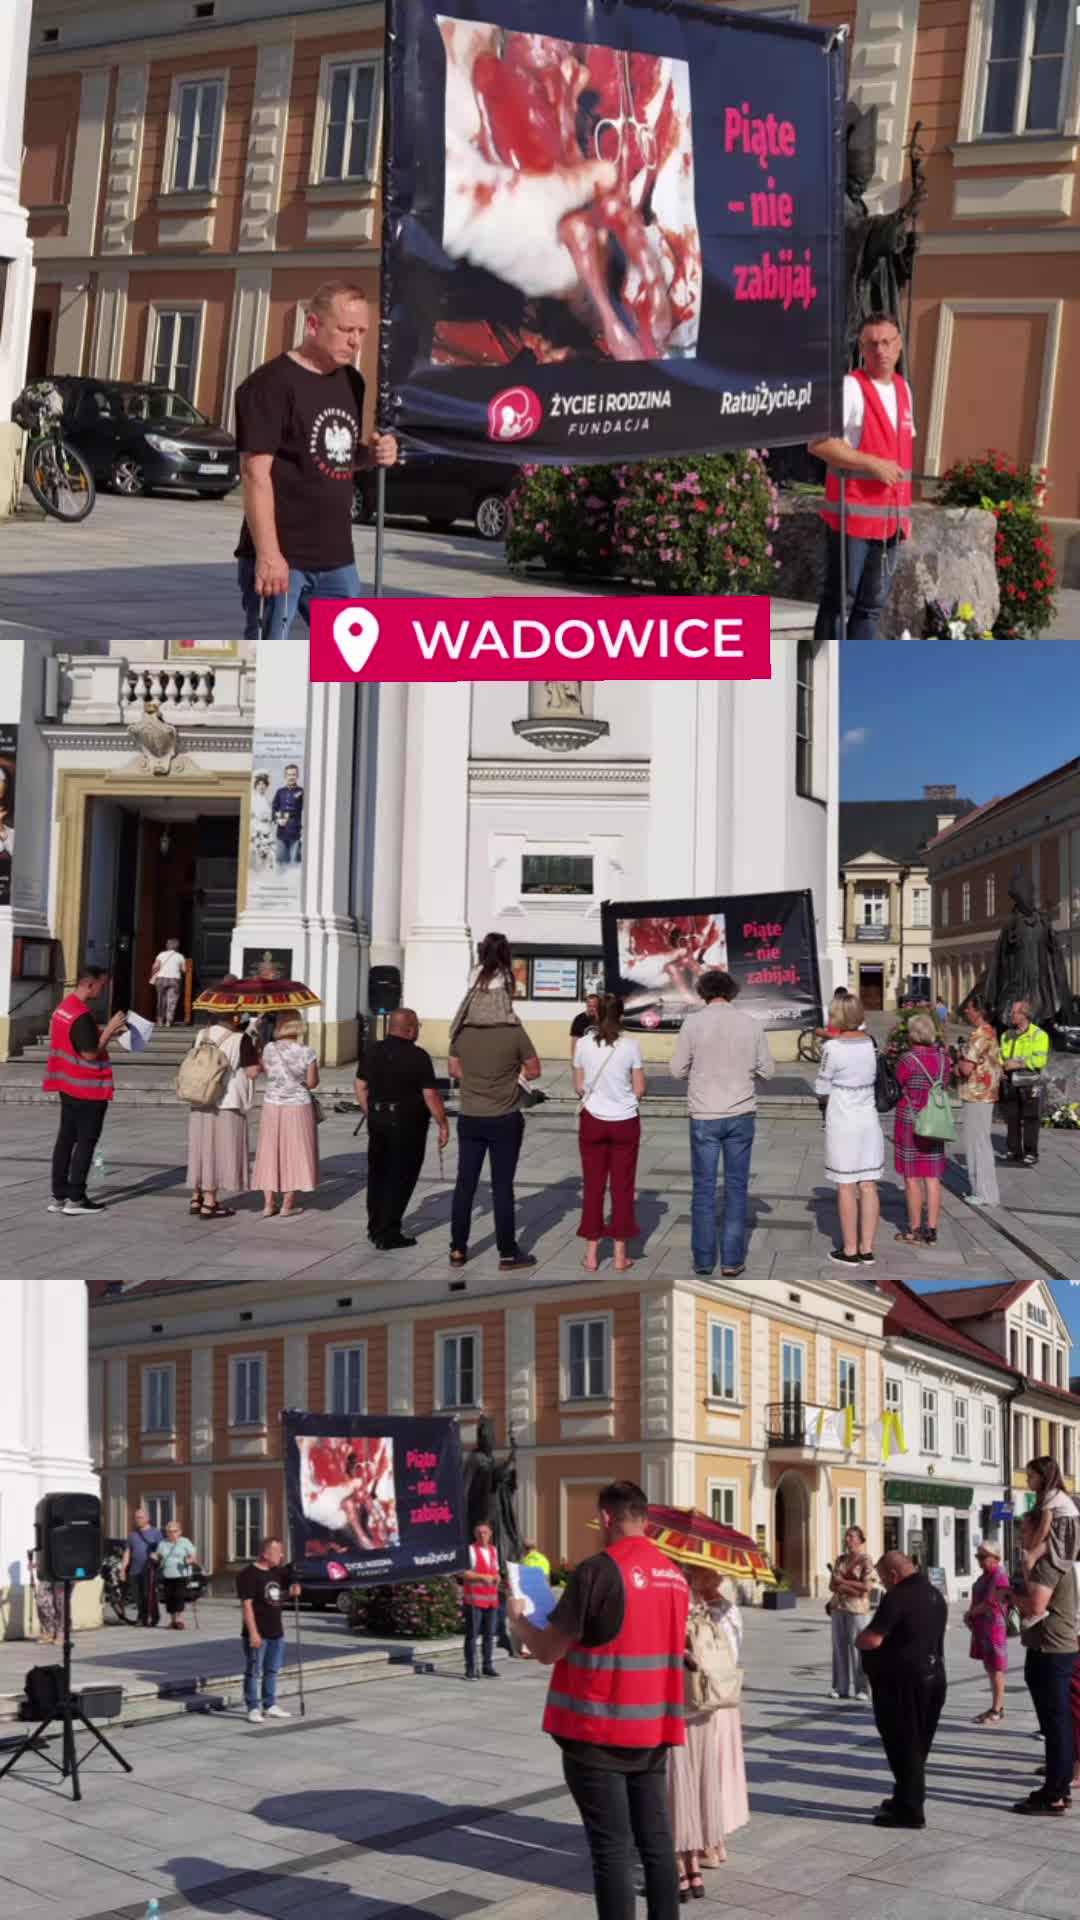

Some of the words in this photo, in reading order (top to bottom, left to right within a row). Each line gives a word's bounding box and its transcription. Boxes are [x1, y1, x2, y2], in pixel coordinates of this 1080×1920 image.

[724, 101, 796, 169] Piąte
[751, 176, 794, 228] nie
[733, 248, 817, 310] zabijaj.
[550, 392, 597, 417] ŻYCIE
[606, 389, 672, 413] RODZINA
[720, 381, 813, 416] RatujŻycie.pl
[567, 417, 650, 437] FUNDACJA
[743, 920, 783, 943] Piąte
[757, 943, 781, 961] nie
